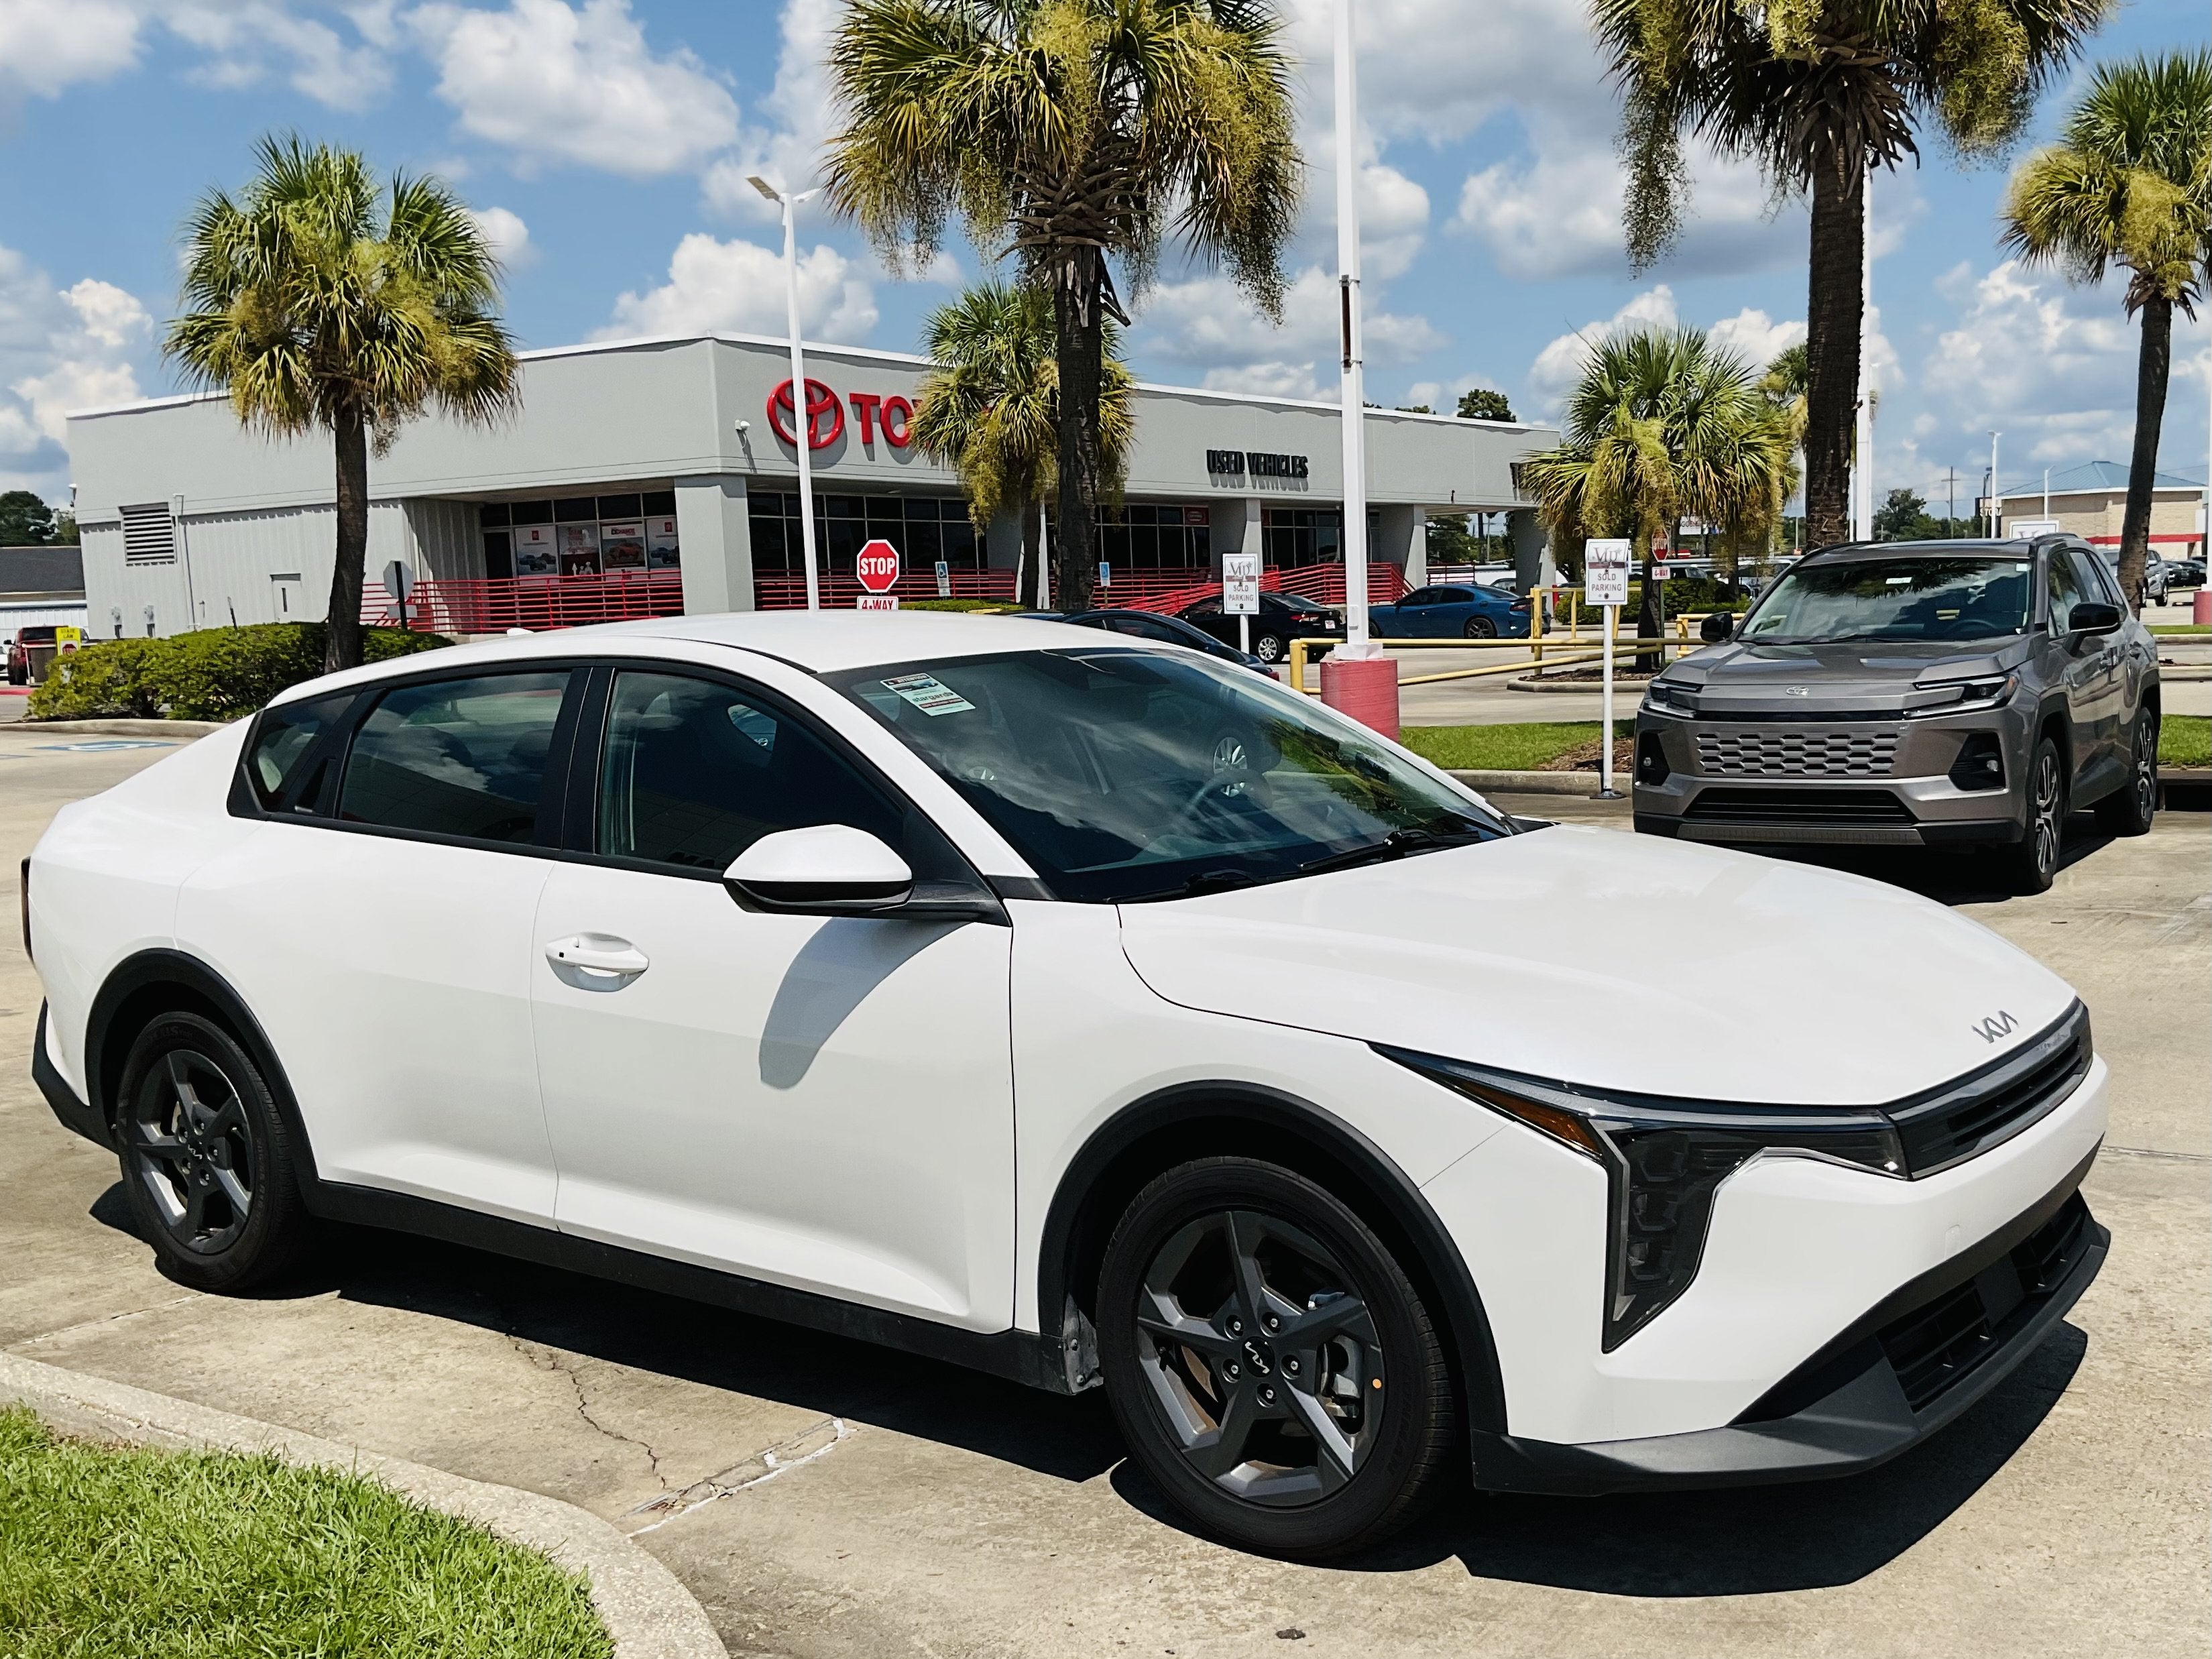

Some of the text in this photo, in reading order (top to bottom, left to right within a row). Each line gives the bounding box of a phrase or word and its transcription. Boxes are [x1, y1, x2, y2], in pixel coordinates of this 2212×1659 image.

[849, 393, 923, 447] TO
[1206, 450, 1309, 478] USED VEHICLES
[1653, 538, 1668, 551] STOP
[860, 557, 896, 575] STOP
[1591, 583, 1622, 591] PARKING
[862, 599, 894, 610] 4-WAY
[1971, 1010, 2020, 1044] KIA
